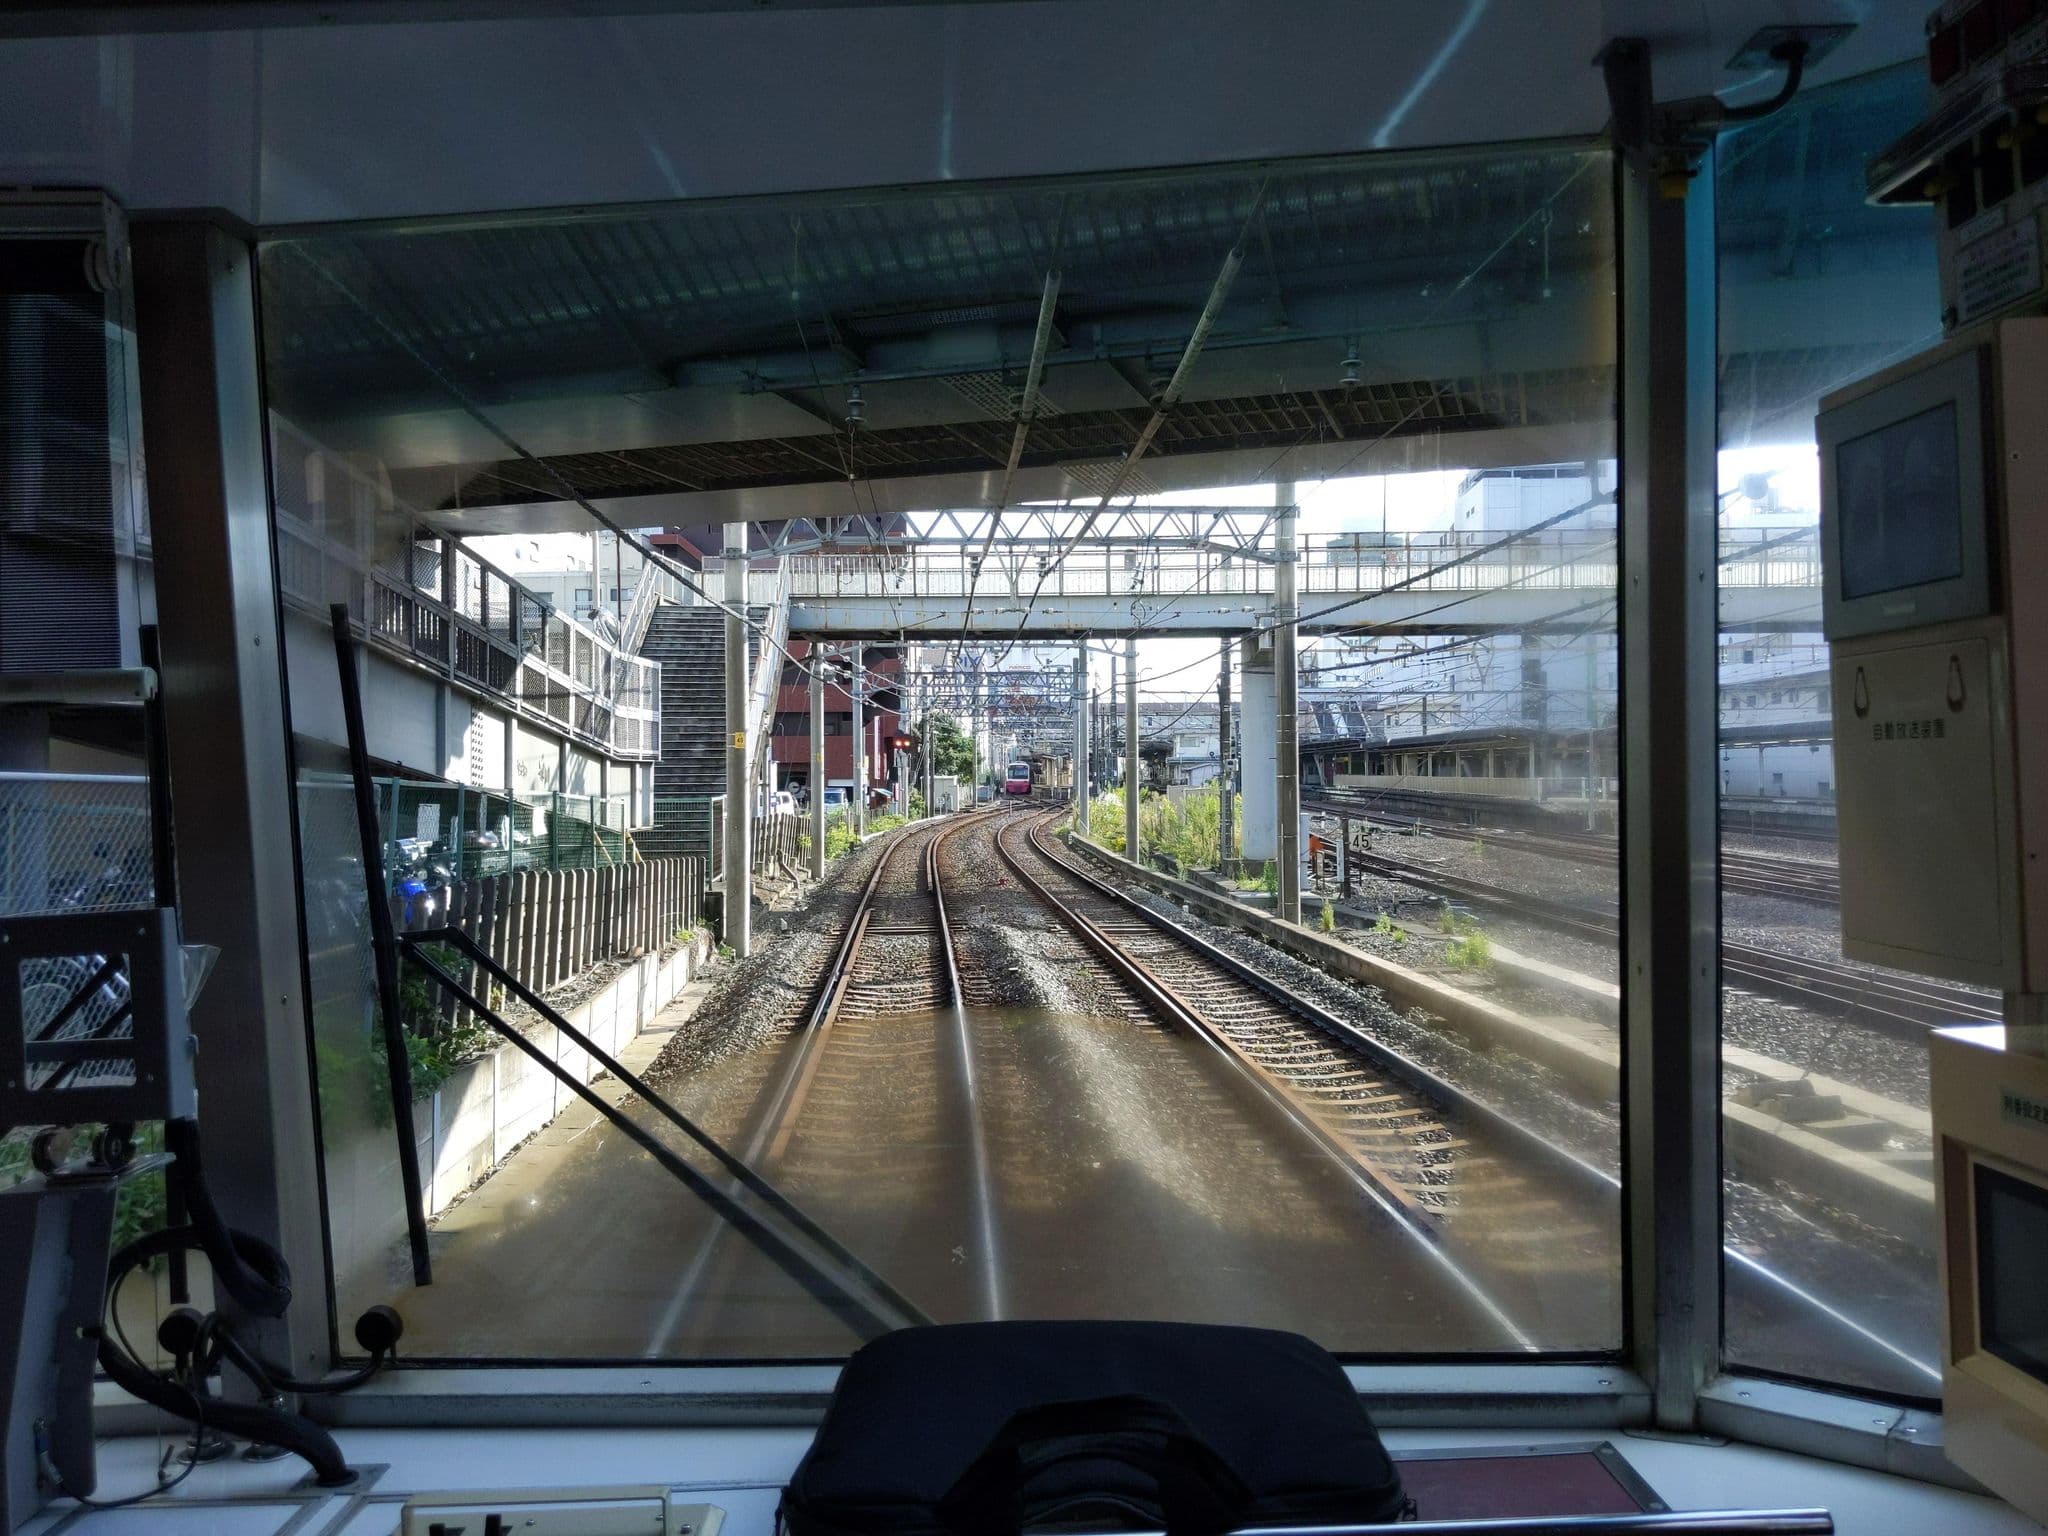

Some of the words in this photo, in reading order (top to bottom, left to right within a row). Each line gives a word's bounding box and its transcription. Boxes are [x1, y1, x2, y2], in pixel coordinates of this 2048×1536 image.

[1872, 718, 1945, 741] 自動放送装置
[1352, 834, 1370, 849] 45
